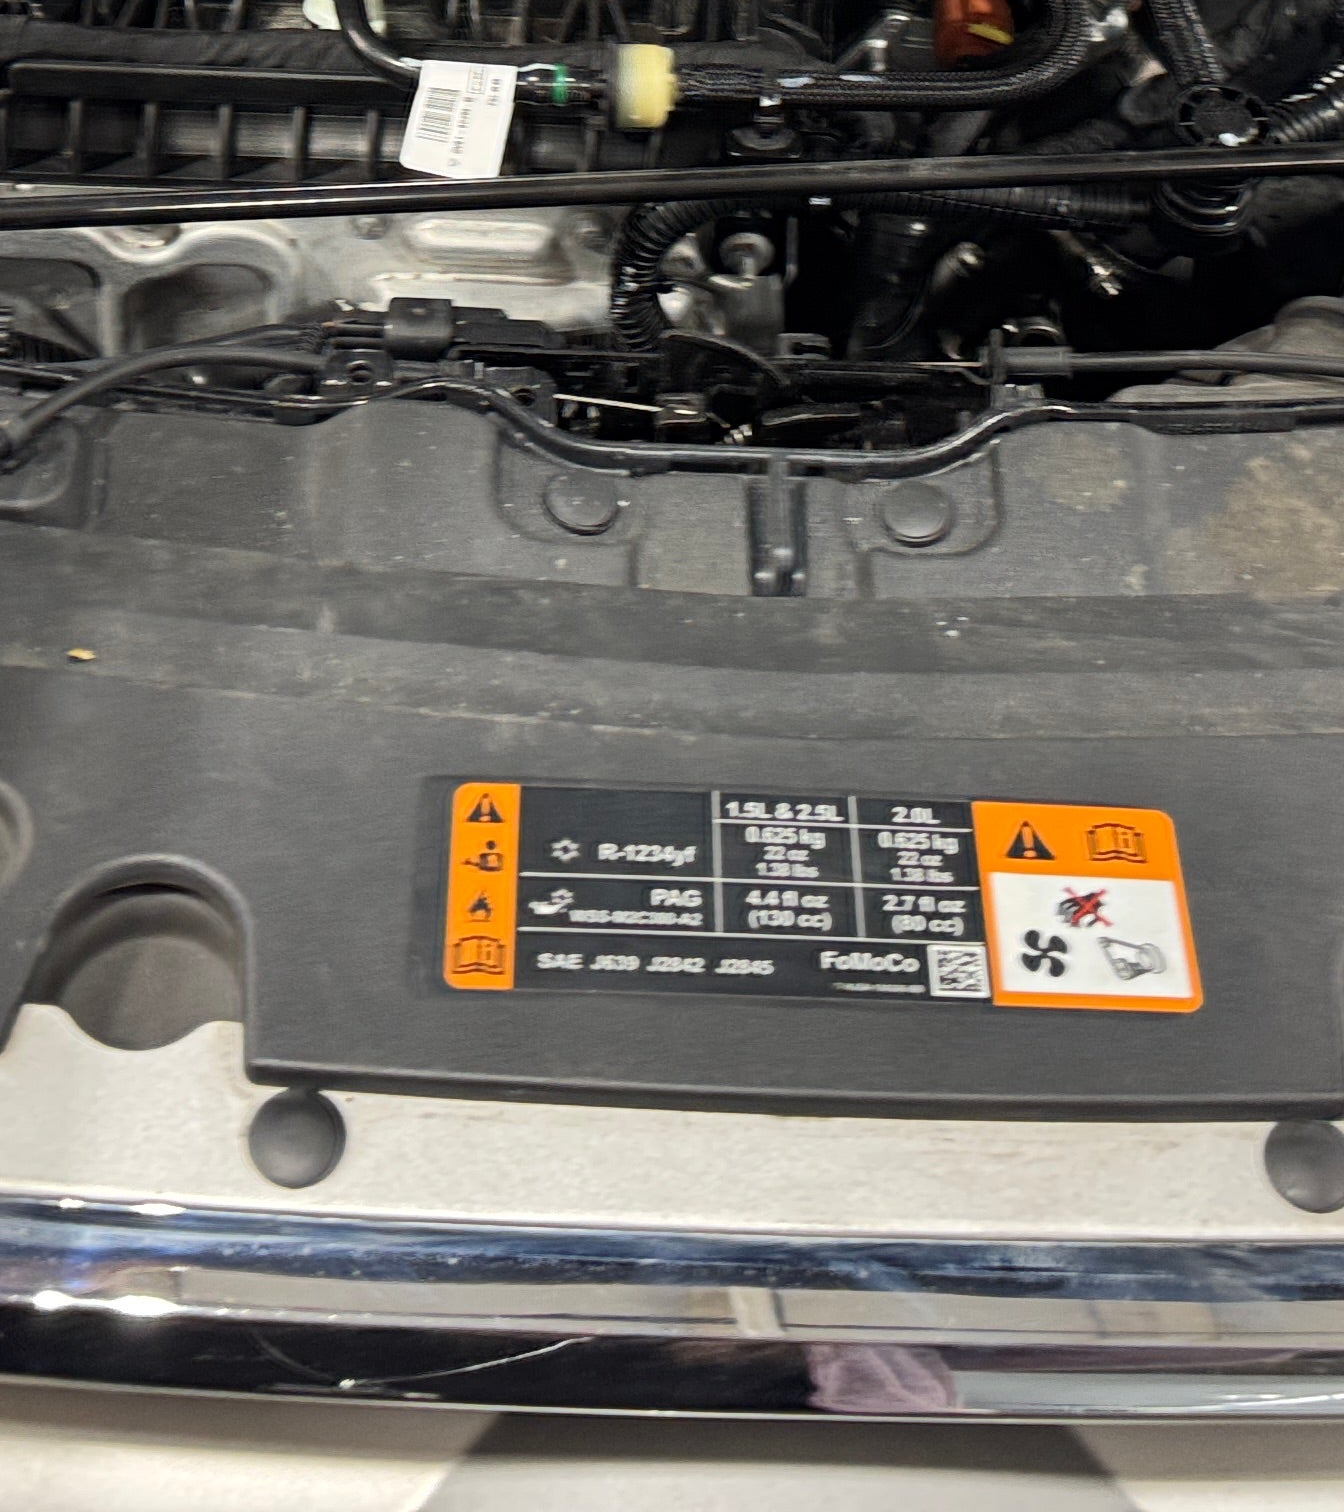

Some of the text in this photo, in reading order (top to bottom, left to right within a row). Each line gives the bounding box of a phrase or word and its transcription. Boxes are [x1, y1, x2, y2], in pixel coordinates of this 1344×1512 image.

[725, 800, 845, 822] 1.5L & 2.5L
[890, 806, 941, 825] 2.0L
[745, 826, 826, 850] 0.625 kg
[877, 831, 960, 855] 0.625 kg
[597, 842, 697, 867] R-1234yf
[763, 845, 810, 862] 22 oz
[896, 850, 944, 867] 22 oz
[650, 888, 704, 908] PAG
[745, 889, 831, 909] 4.4 fl oz
[881, 894, 967, 914] 2.7 fl oz
[796, 911, 833, 932] cc)
[928, 916, 965, 937] cc)
[536, 952, 584, 971] SAE
[589, 954, 641, 972] J639
[819, 950, 921, 973] FoMoCo
